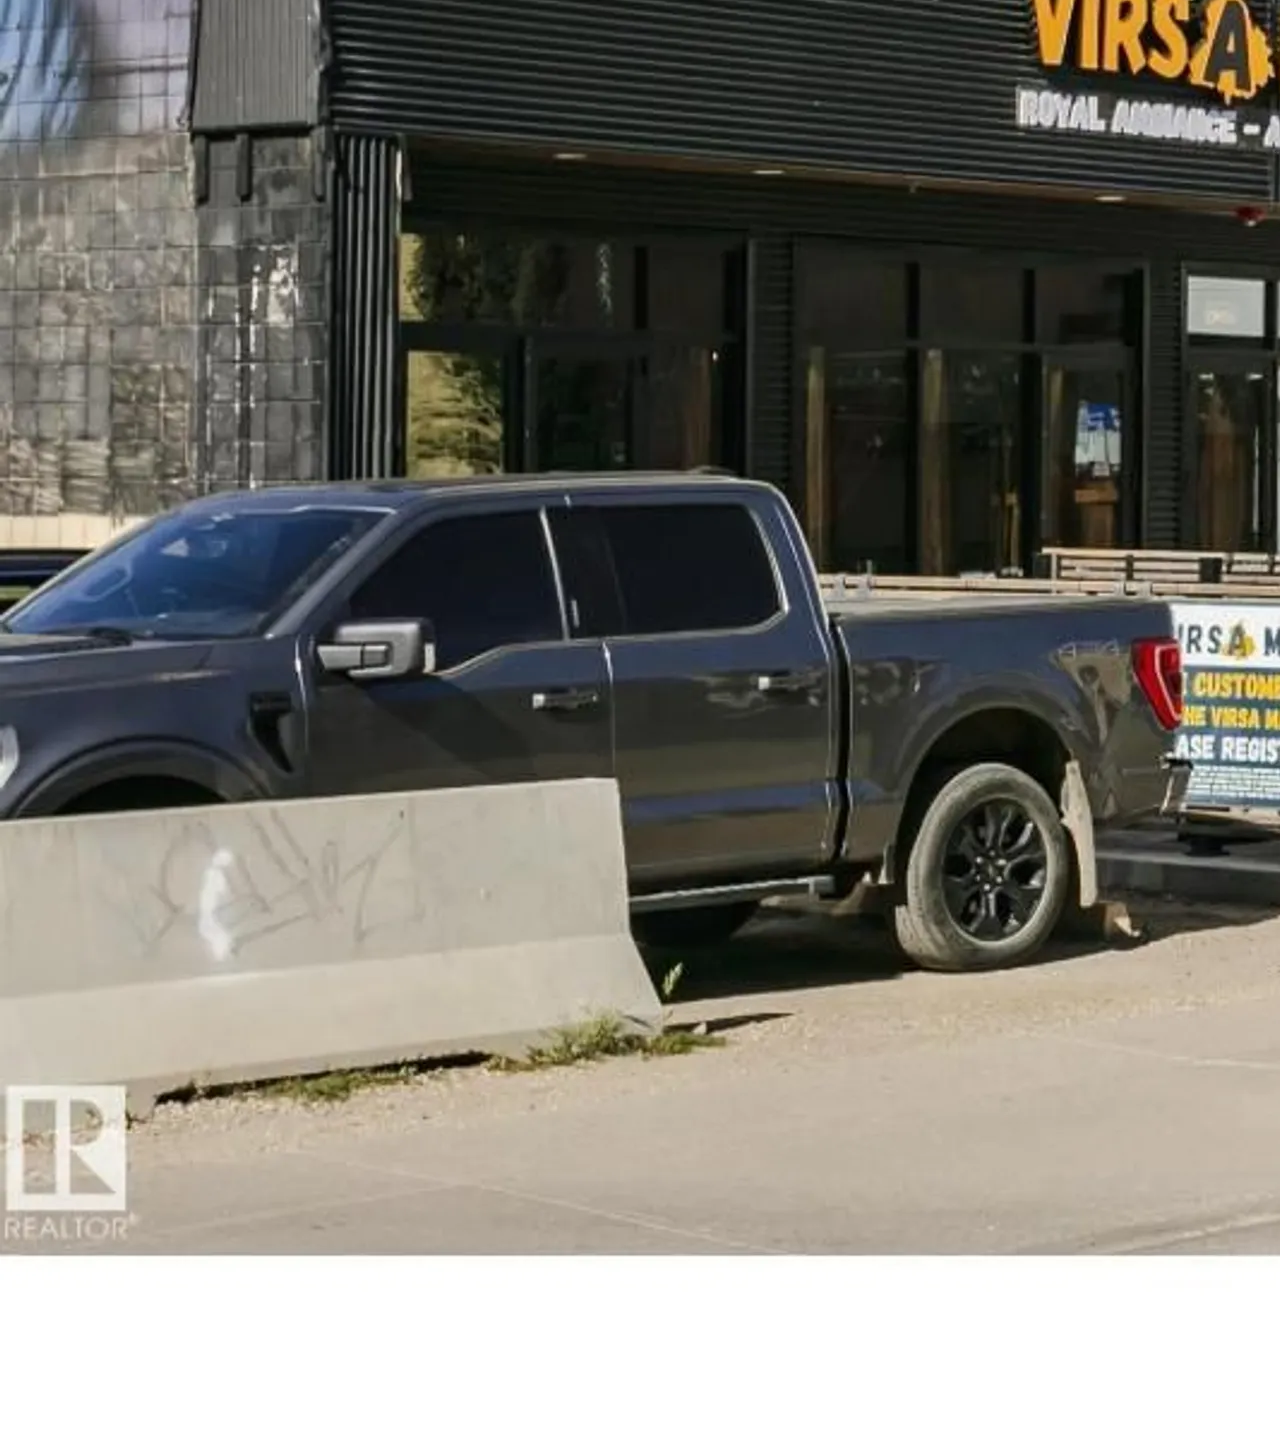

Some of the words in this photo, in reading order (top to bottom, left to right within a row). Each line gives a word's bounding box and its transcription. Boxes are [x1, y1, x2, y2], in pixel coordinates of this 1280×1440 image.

[1016, 87, 1106, 132] ROYAL
[1178, 621, 1249, 658] IRSA
[1181, 706, 1207, 727] HE
[1211, 707, 1260, 730] VIRSA
